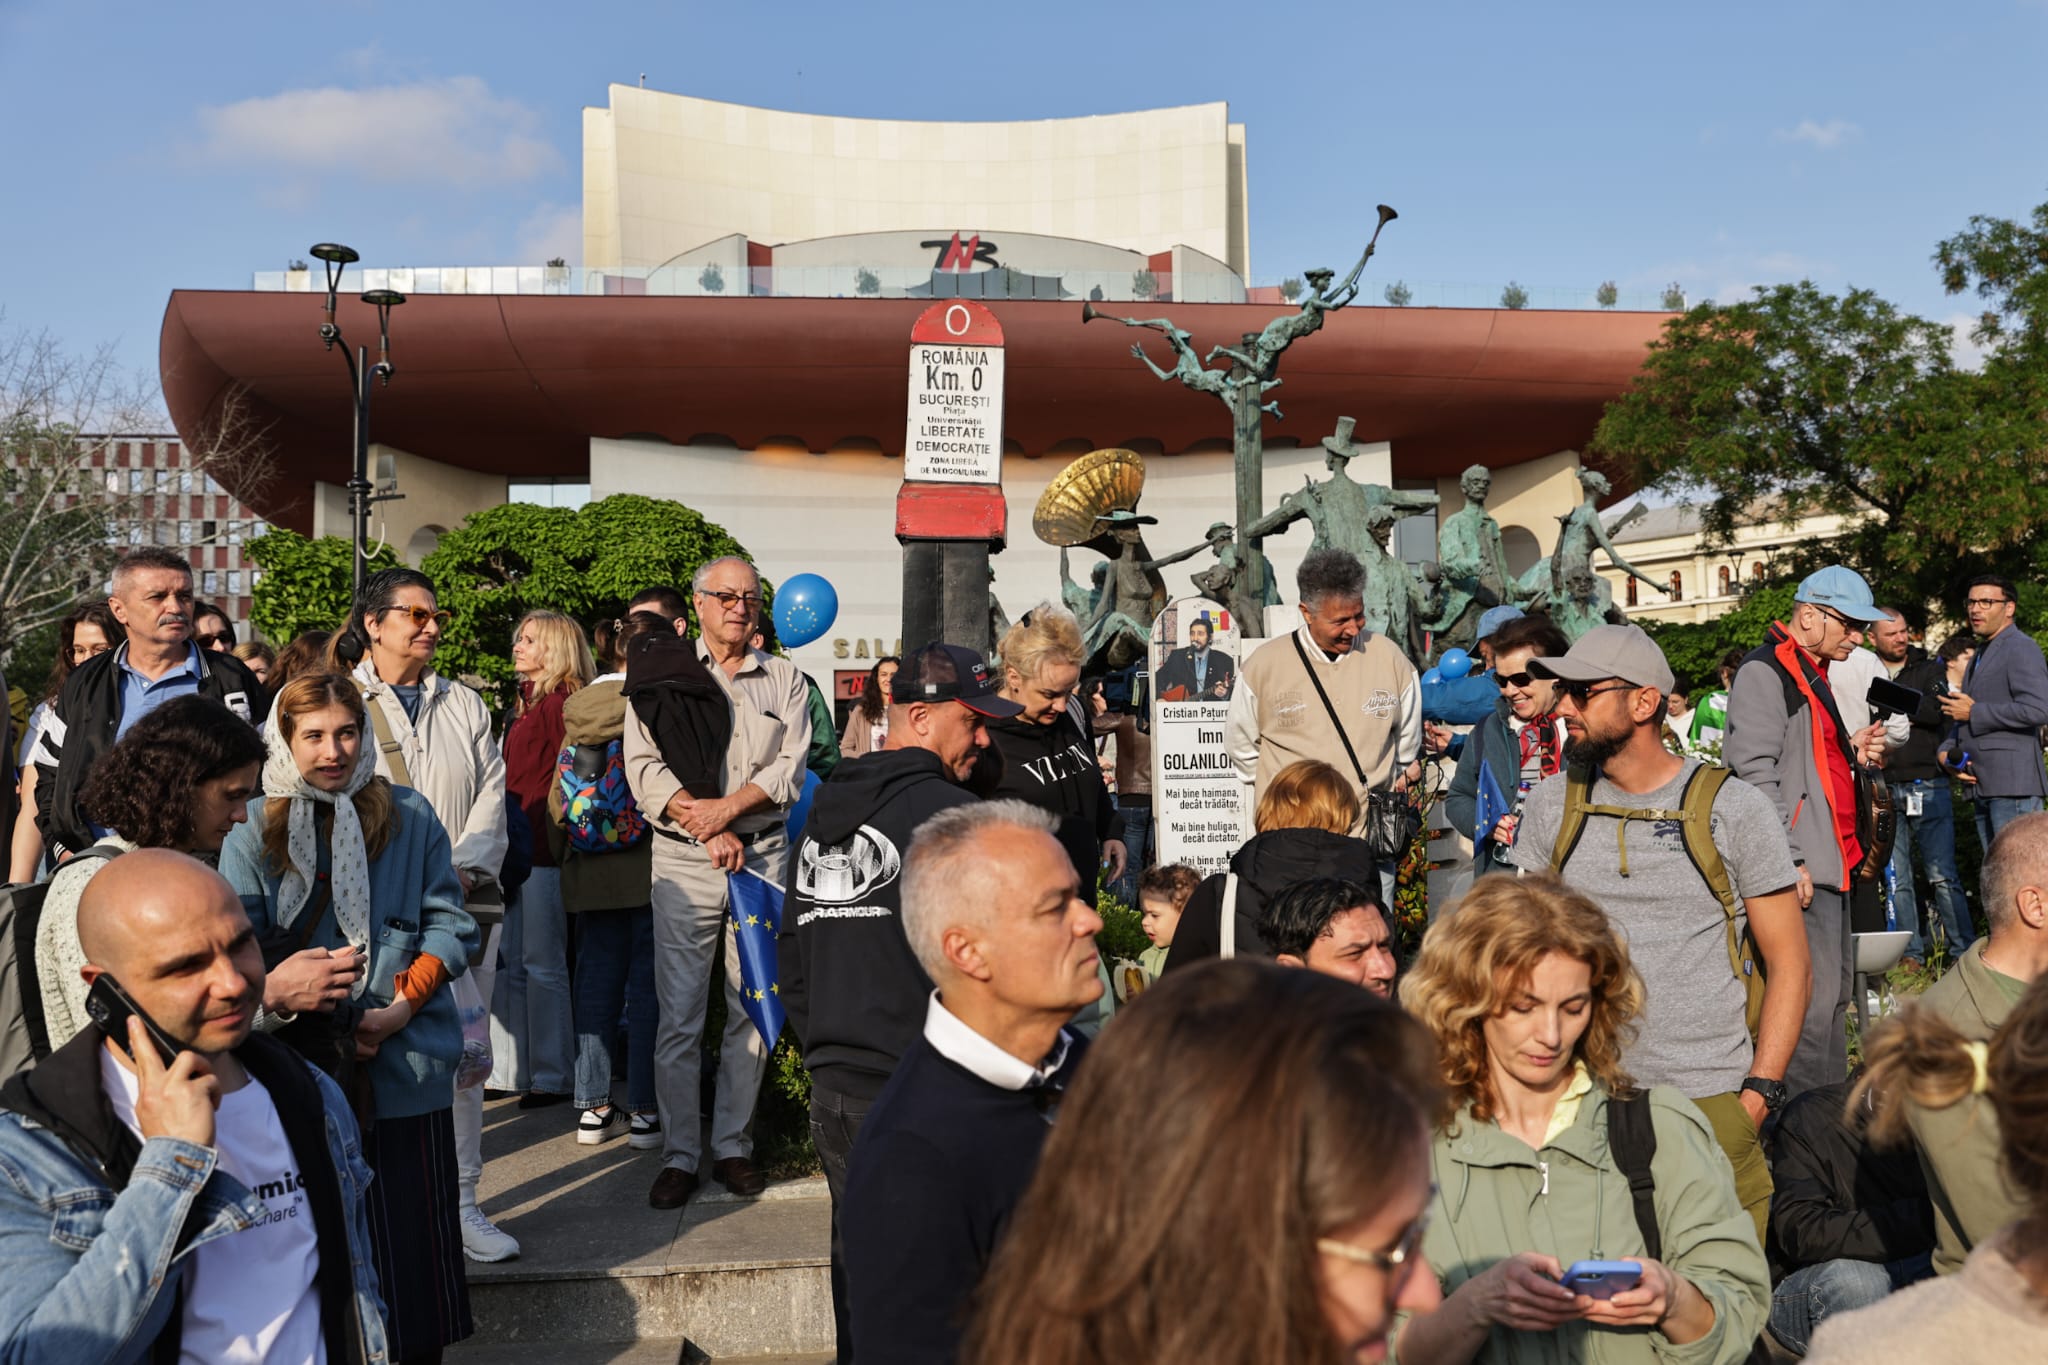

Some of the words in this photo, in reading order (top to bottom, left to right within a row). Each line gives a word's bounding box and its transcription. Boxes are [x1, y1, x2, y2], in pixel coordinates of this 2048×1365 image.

[921, 348, 988, 366] ROMÂNIA
[972, 366, 983, 391] 0
[919, 394, 990, 408] BUCUREȘTI
[921, 425, 985, 438] LIBERTATE
[916, 440, 991, 456] DEMOCRAȚIE
[929, 457, 950, 465] ZONA
[1163, 706, 1198, 719] Cristian
[1198, 727, 1223, 744] Imn
[1165, 788, 1180, 799] Mai
[1182, 788, 1200, 798] bine
[1202, 787, 1239, 799] haimana,
[1180, 799, 1202, 810] decât
[1171, 822, 1186, 832] Mai
[1188, 822, 1205, 832] bine
[1207, 821, 1240, 833] huligan,
[1182, 833, 1205, 843] decât
[1207, 832, 1241, 843] dictator,
[1180, 856, 1194, 866] Mai
[1197, 855, 1214, 865] bine
